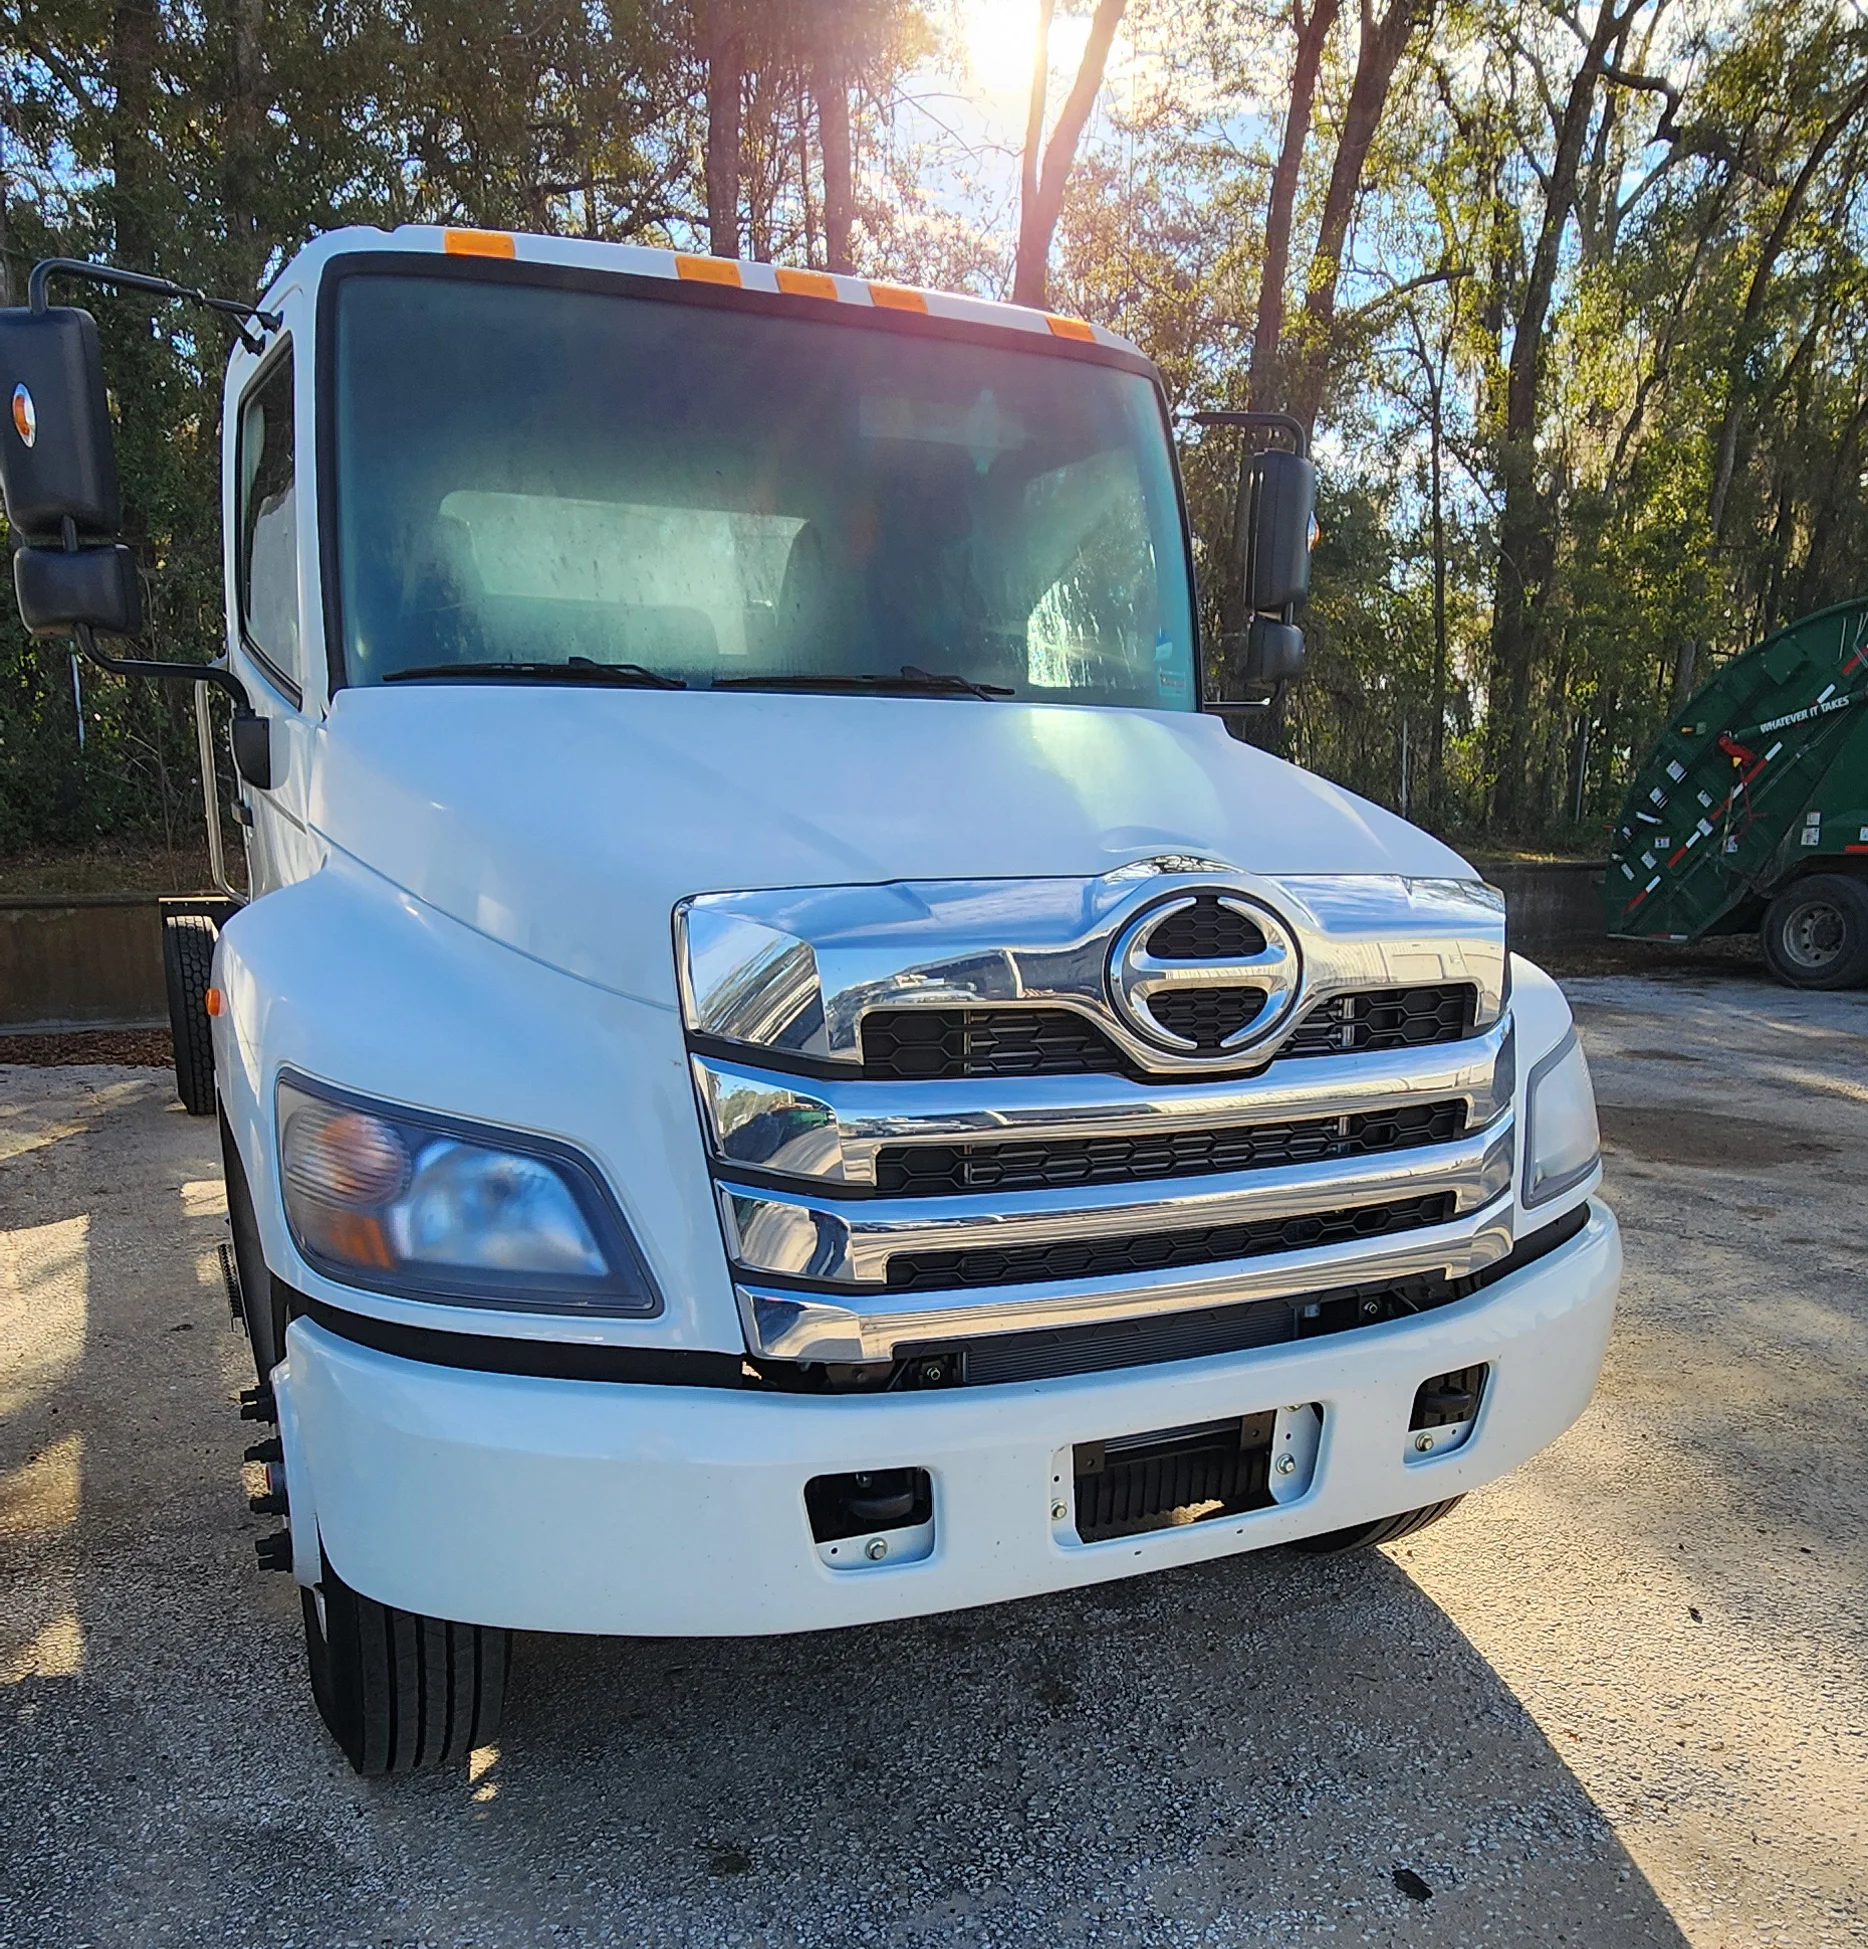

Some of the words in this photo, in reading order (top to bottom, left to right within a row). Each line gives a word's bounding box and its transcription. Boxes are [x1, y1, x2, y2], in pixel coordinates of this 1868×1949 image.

[1760, 708, 1808, 733] WHATEVER
[1809, 705, 1819, 717] IT
[1820, 695, 1850, 713] TAKES
